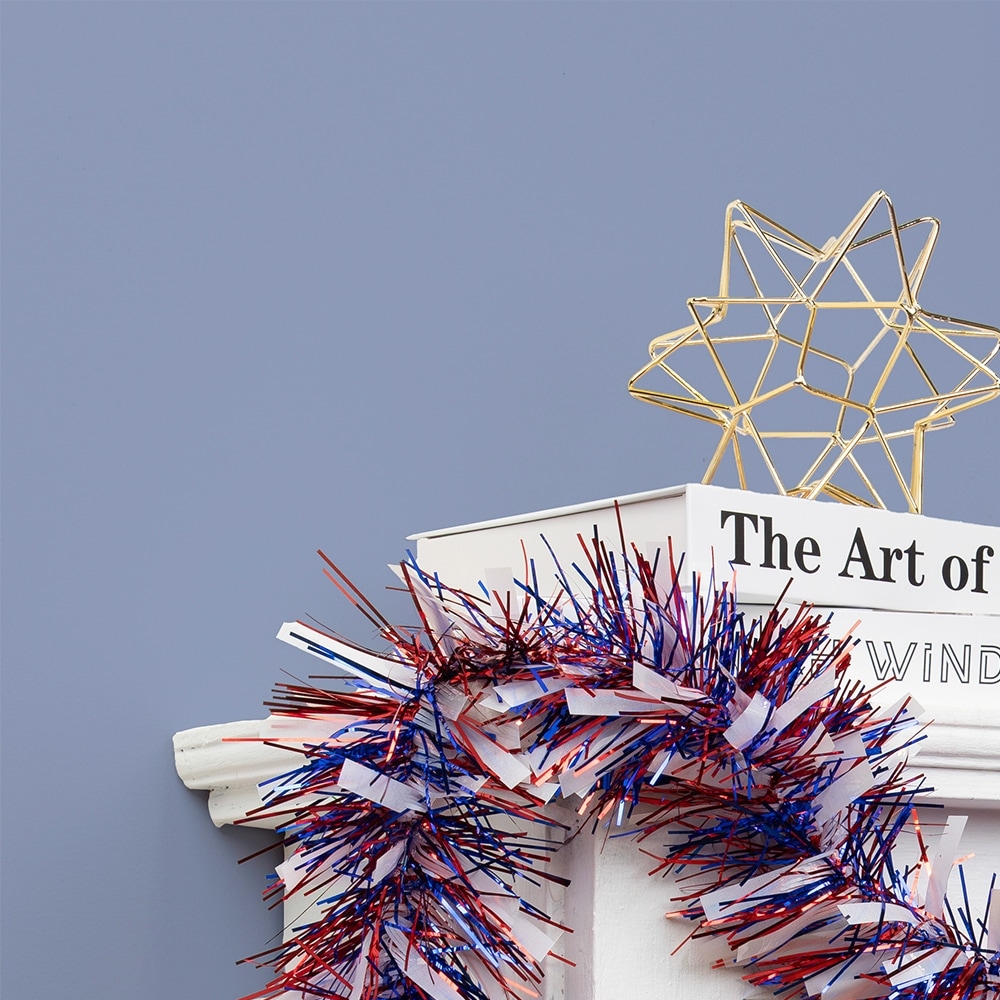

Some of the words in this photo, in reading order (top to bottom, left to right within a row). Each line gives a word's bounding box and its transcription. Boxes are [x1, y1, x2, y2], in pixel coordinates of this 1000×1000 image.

[720, 510, 822, 574] The
[838, 527, 925, 587] Art
[942, 545, 995, 594] of
